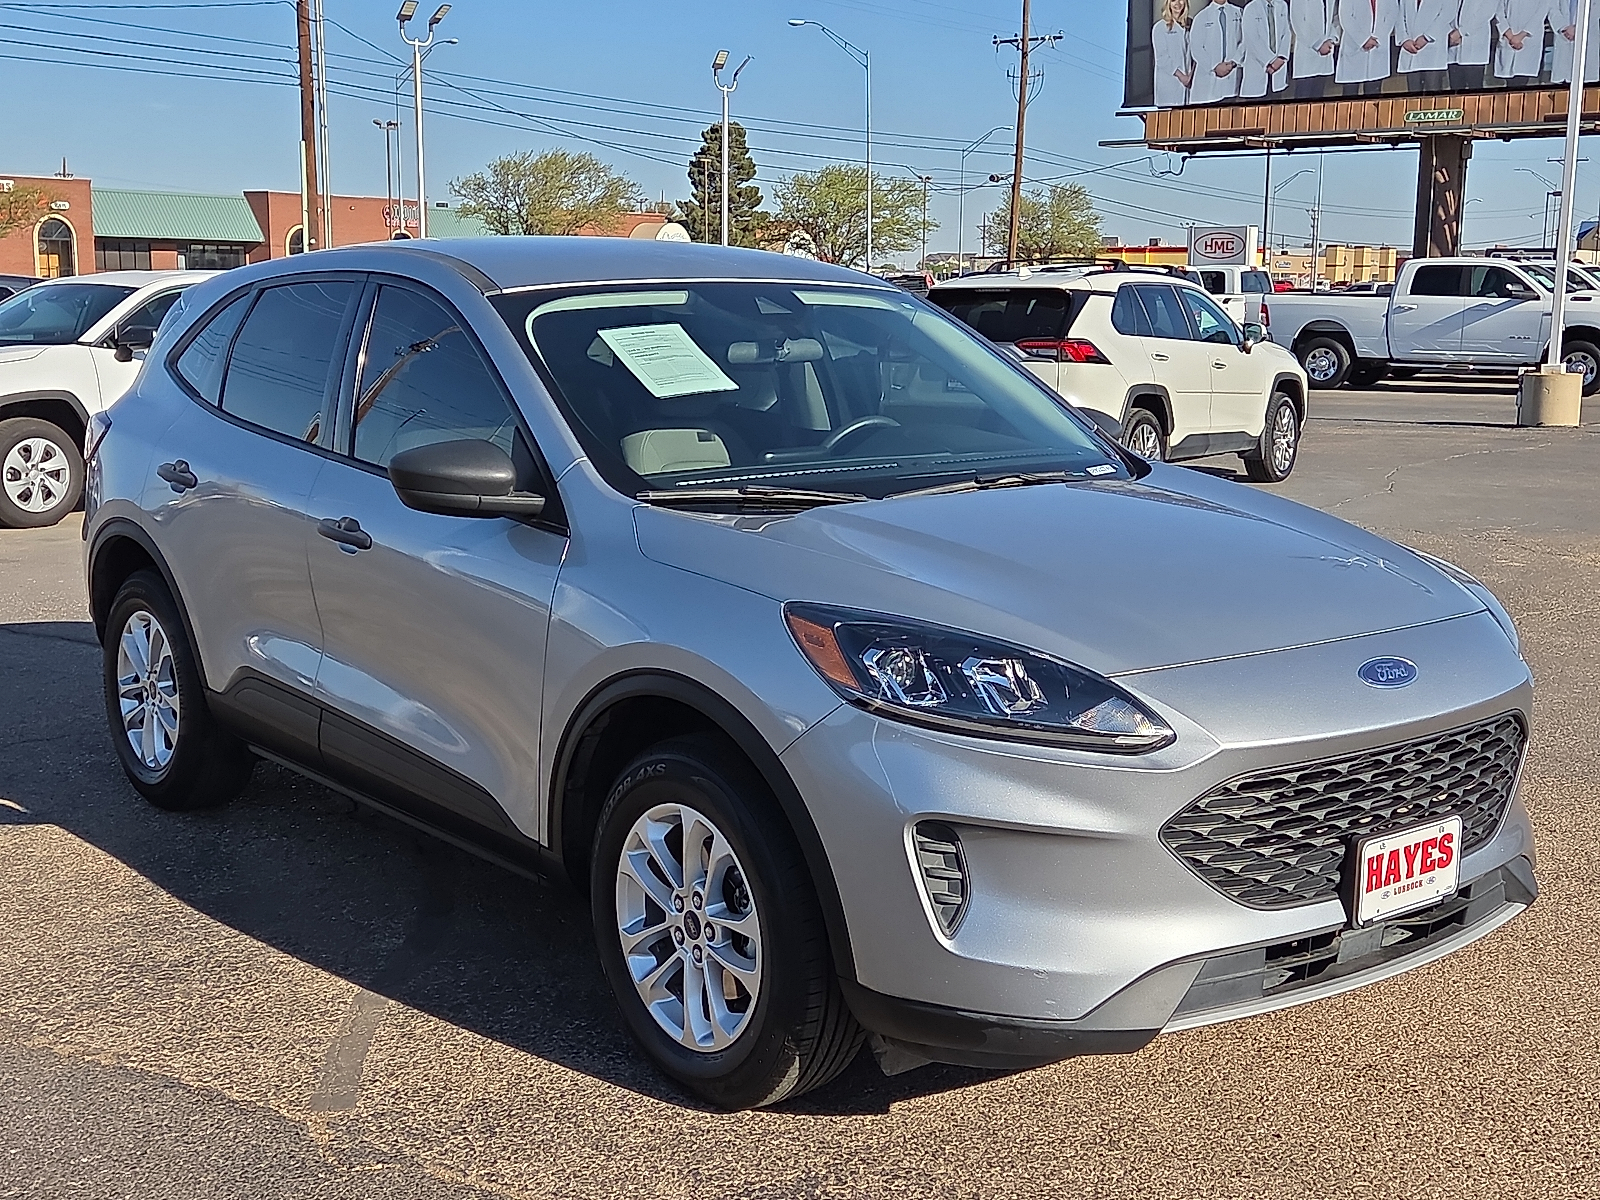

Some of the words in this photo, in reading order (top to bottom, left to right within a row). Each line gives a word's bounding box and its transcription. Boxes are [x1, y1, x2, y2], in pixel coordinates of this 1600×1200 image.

[1409, 111, 1458, 120] LAMAR
[1204, 238, 1235, 254] HMC
[1375, 662, 1408, 681] Ford
[636, 763, 666, 780] 4XS
[1366, 833, 1454, 894] HAYES
